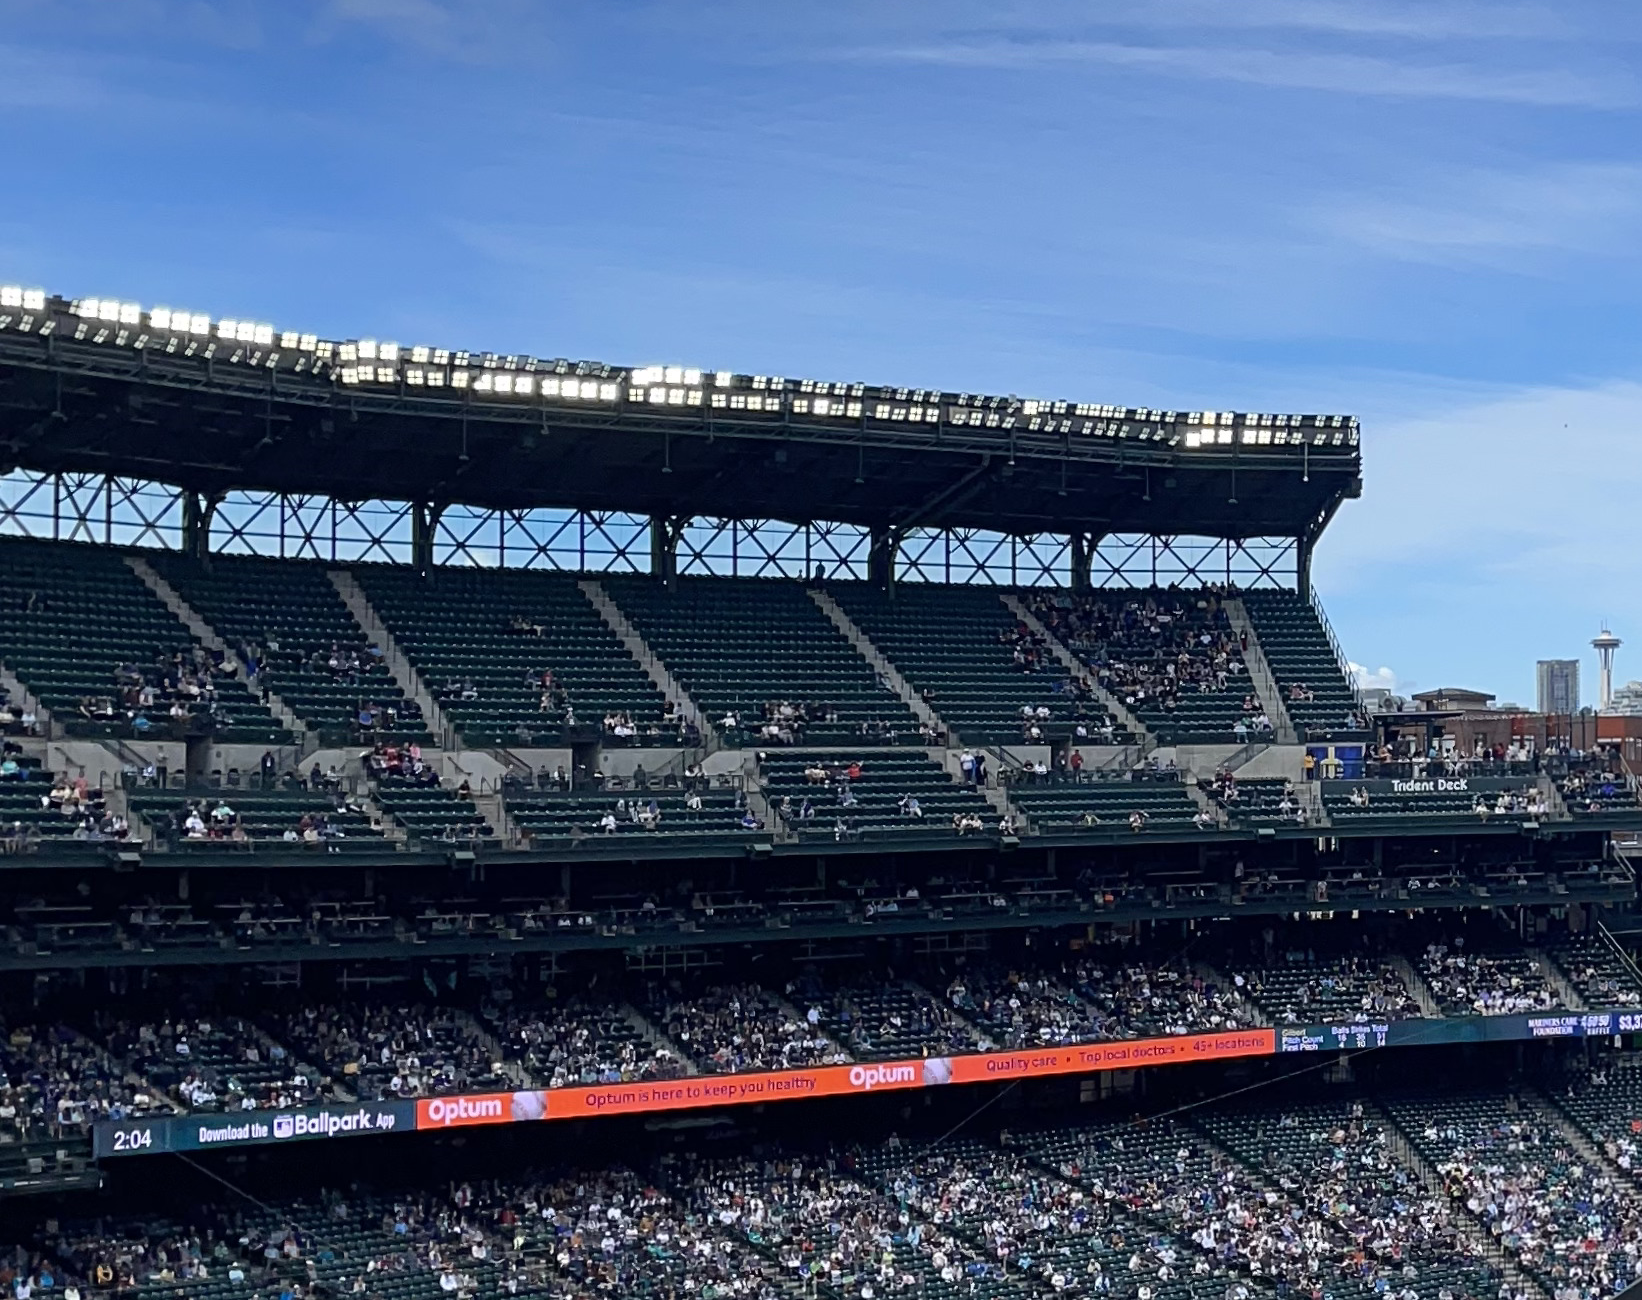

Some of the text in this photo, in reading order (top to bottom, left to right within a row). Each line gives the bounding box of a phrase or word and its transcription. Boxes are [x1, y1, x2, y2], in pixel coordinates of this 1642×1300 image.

[1391, 778, 1468, 792] Trident Deck
[1214, 1036, 1265, 1050] locations
[1079, 1044, 1176, 1064] Top local doctors
[986, 1056, 1057, 1073] Quality care
[850, 1063, 914, 1089] Optum
[586, 1075, 817, 1108] Optum is here to keep you healthy
[429, 1099, 502, 1121] Optum
[199, 1110, 395, 1143] Download the Ballpark App
[114, 1131, 151, 1151] 2:04
